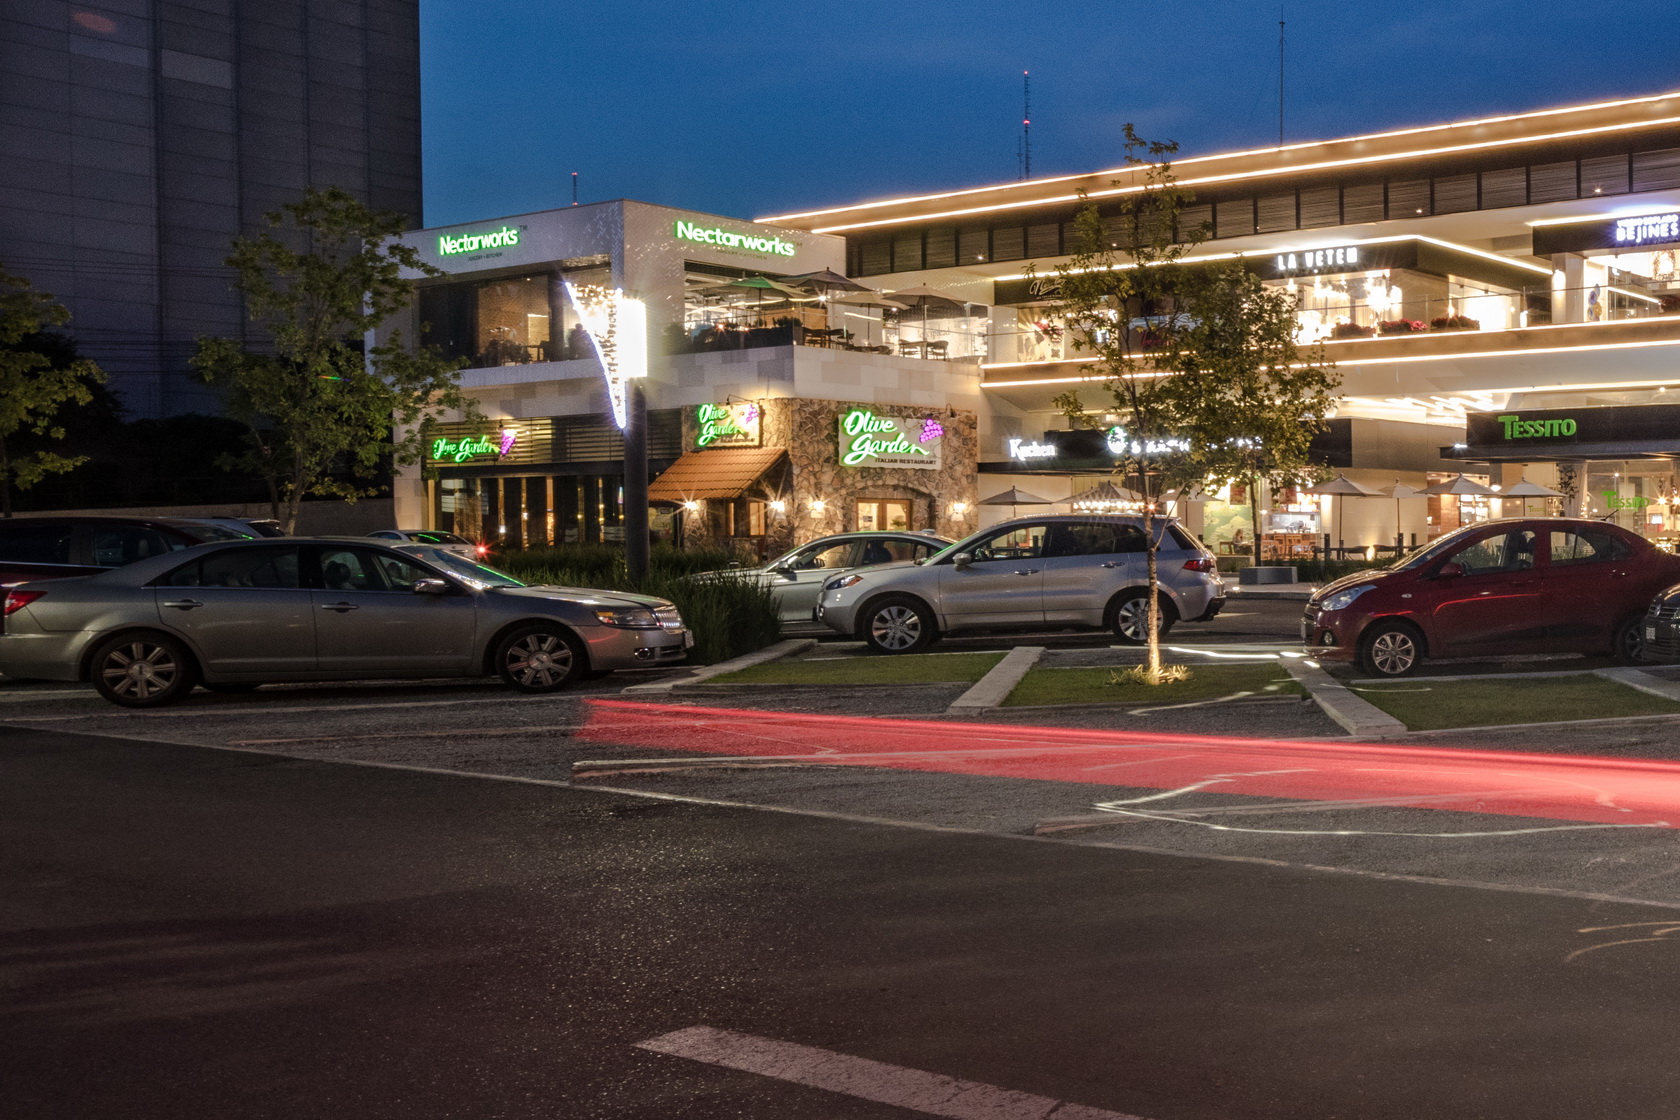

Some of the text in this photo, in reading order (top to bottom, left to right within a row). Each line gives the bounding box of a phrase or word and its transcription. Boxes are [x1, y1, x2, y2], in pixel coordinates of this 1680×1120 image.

[440, 226, 518, 256] Nectarworks
[676, 220, 795, 256] Nectarworks
[1277, 253, 1297, 270] LA
[698, 403, 728, 423] Olive
[844, 411, 898, 436] Olive
[698, 418, 747, 446] Garden
[1498, 415, 1577, 440] TESSITO
[454, 434, 500, 463] Garden
[843, 432, 930, 465] Garden
